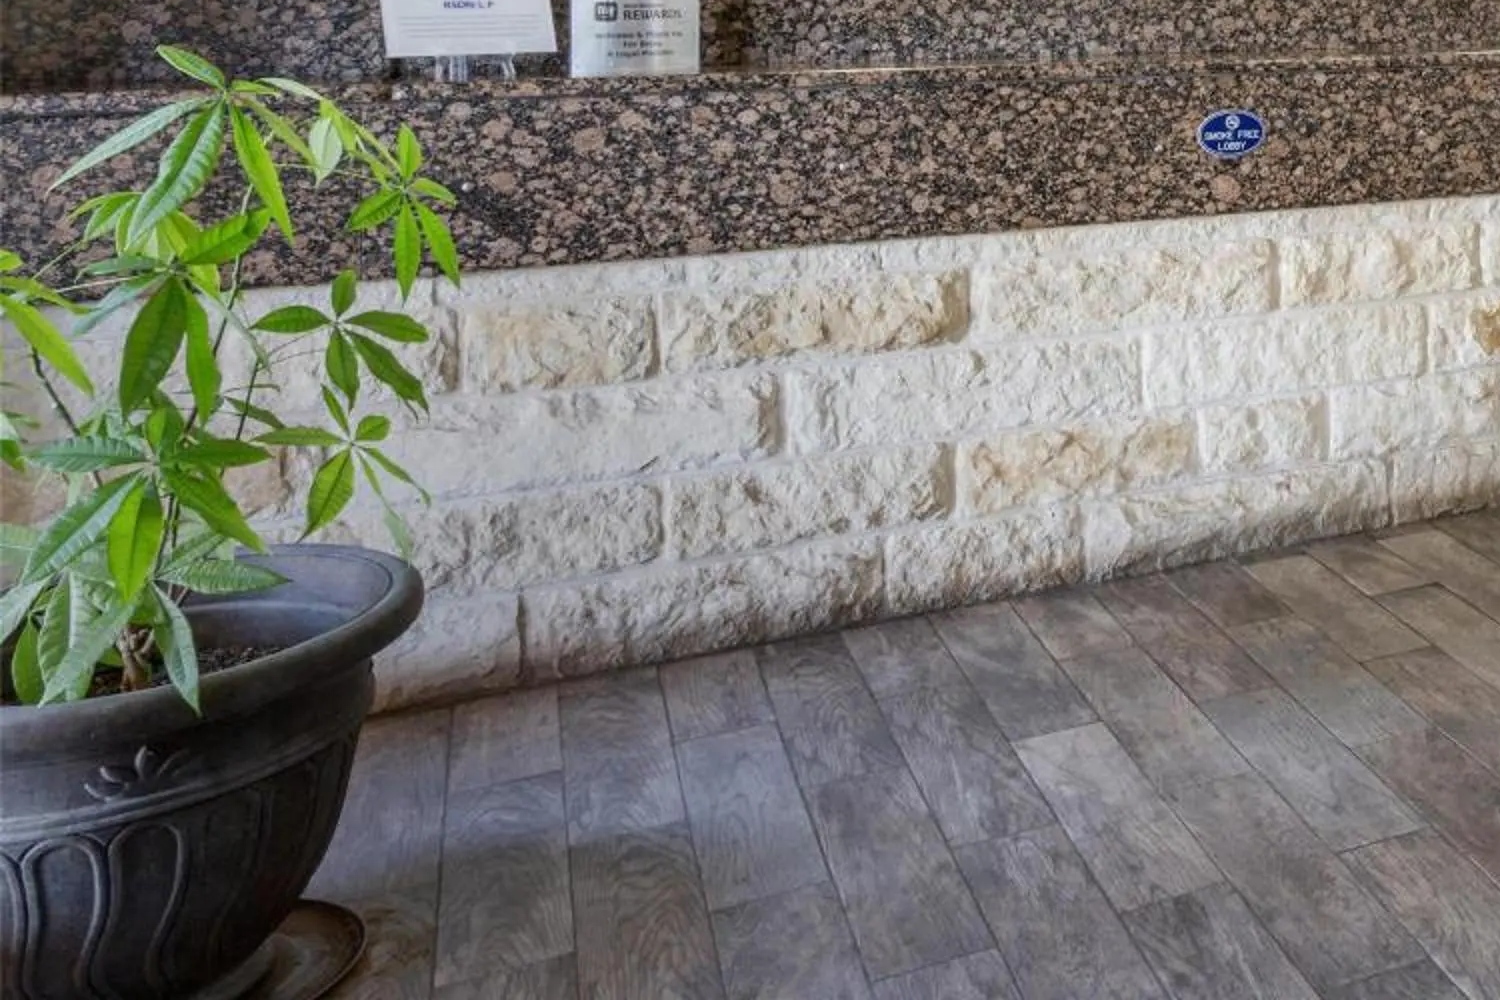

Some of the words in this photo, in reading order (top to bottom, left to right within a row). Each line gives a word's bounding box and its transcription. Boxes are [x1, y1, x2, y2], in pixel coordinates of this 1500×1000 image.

[1204, 131, 1233, 141] SMOKE
[1237, 129, 1260, 139] FREE
[1217, 141, 1247, 151] LOBBY
